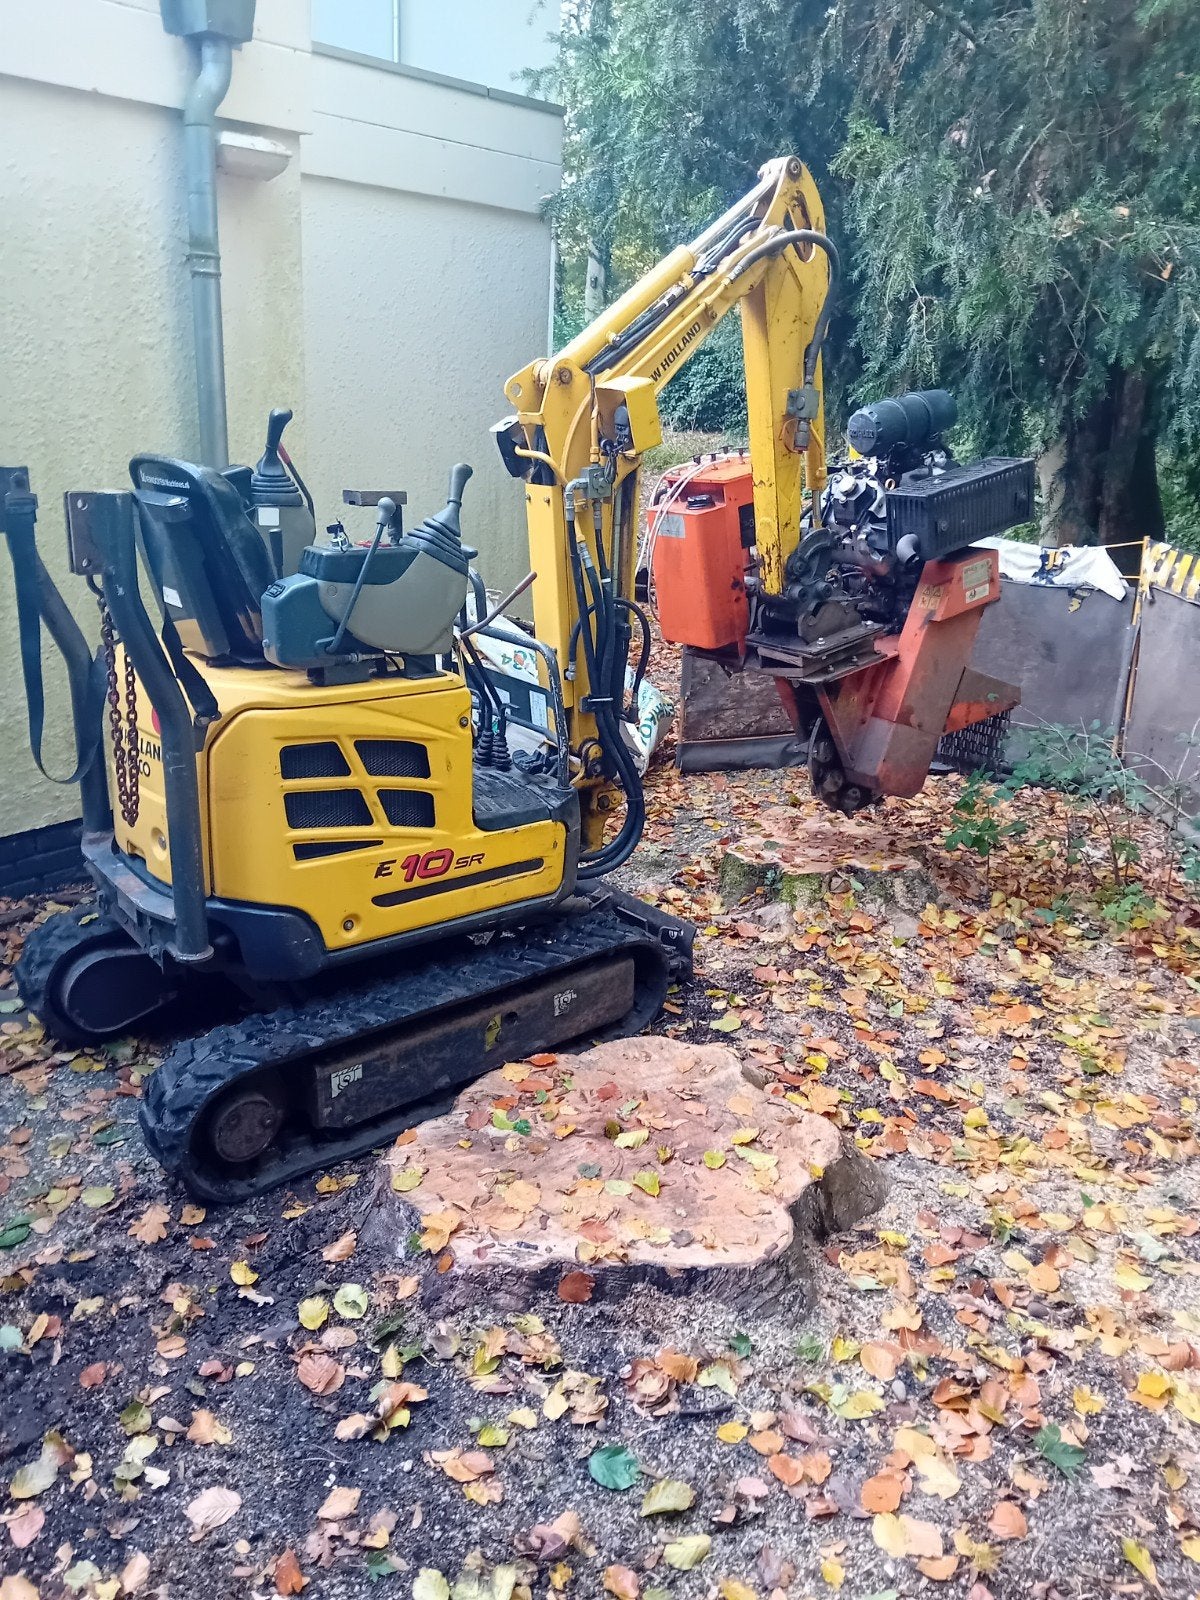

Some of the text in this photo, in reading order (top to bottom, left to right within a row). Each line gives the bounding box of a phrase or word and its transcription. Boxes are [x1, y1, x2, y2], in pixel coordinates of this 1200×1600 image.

[660, 321, 701, 371] HOLLAND
[400, 848, 455, 882] 10
[454, 853, 485, 870] SR
